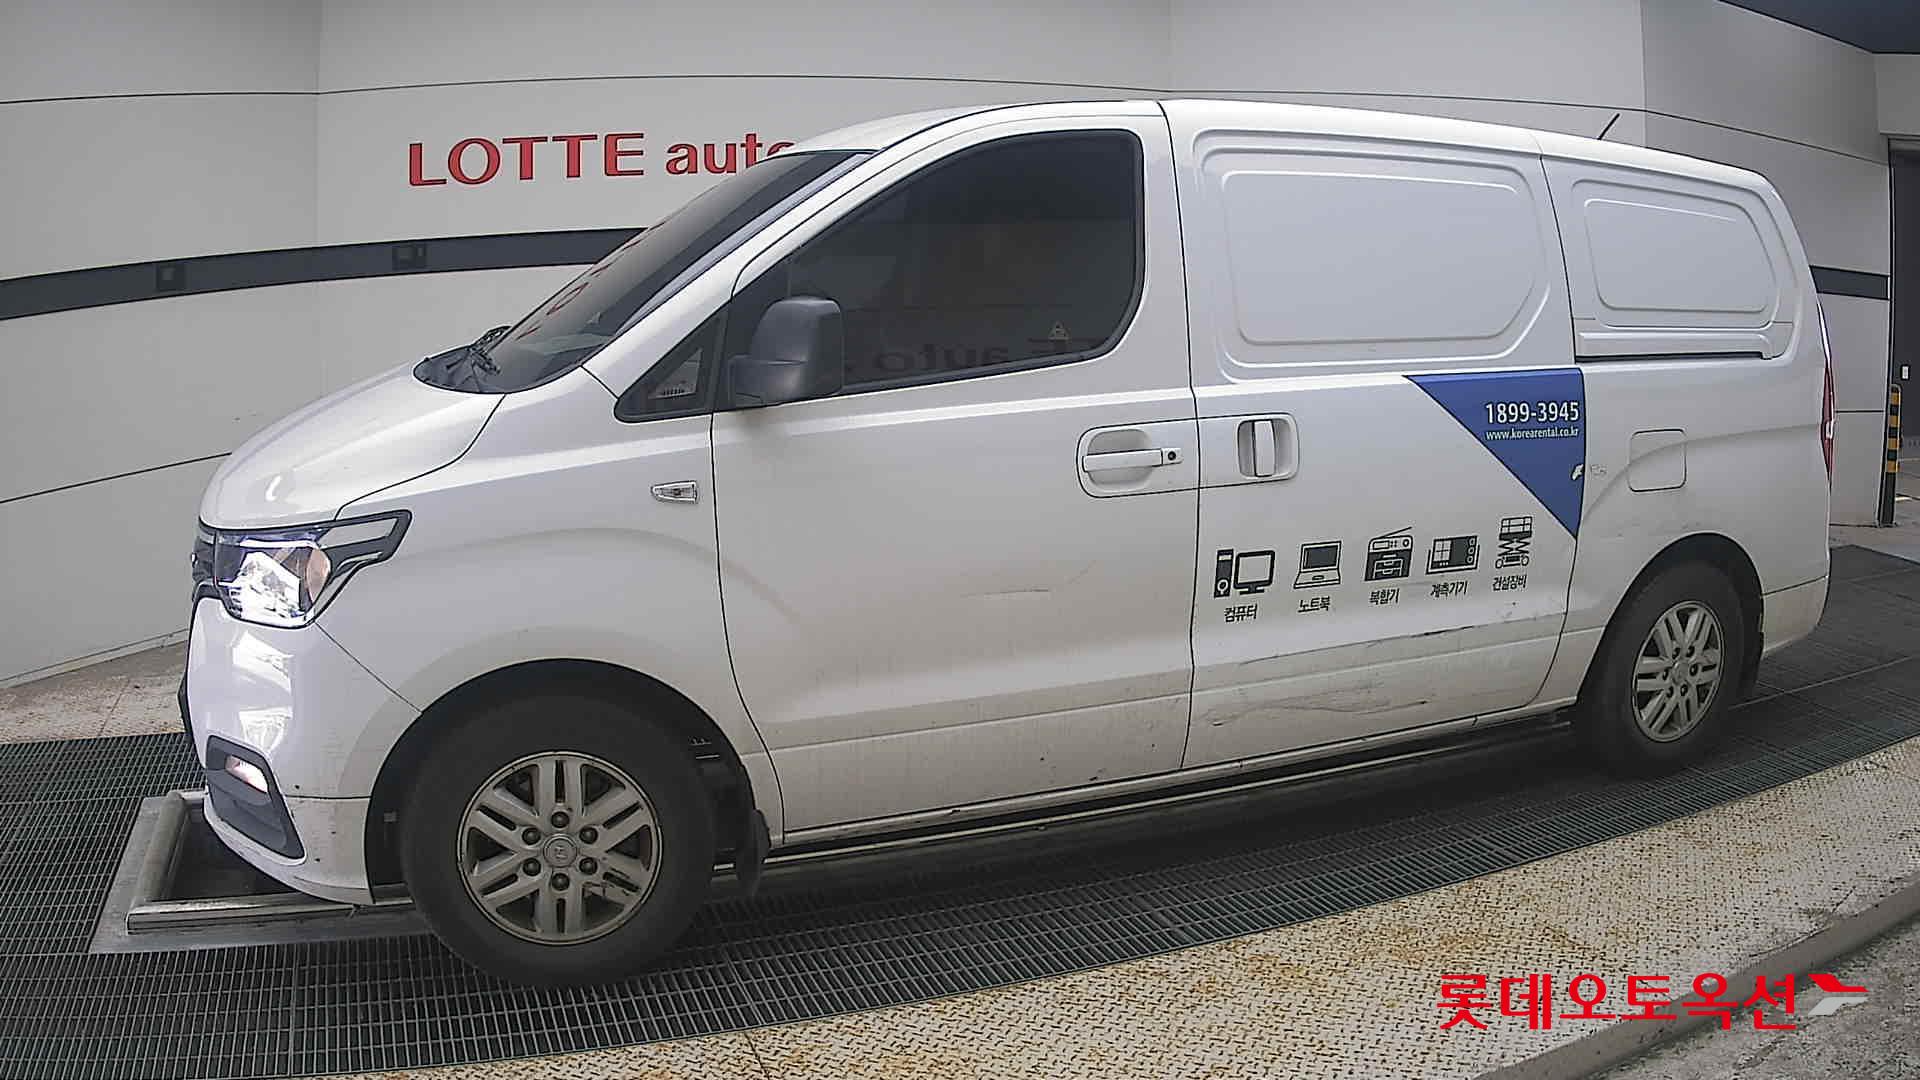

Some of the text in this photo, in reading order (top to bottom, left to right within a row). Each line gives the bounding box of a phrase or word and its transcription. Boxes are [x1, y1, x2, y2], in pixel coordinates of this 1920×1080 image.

[408, 132, 645, 186] LOTTE
[1486, 402, 1579, 424] 1899-3945
[1486, 426, 1579, 440] www.korearental.co.kr
[1430, 580, 1468, 599] 계측기기
[1492, 574, 1528, 592] 건설장비
[1298, 596, 1331, 614] 노트북
[1369, 588, 1401, 606] 복합기
[1224, 604, 1258, 623] 컴퓨터
